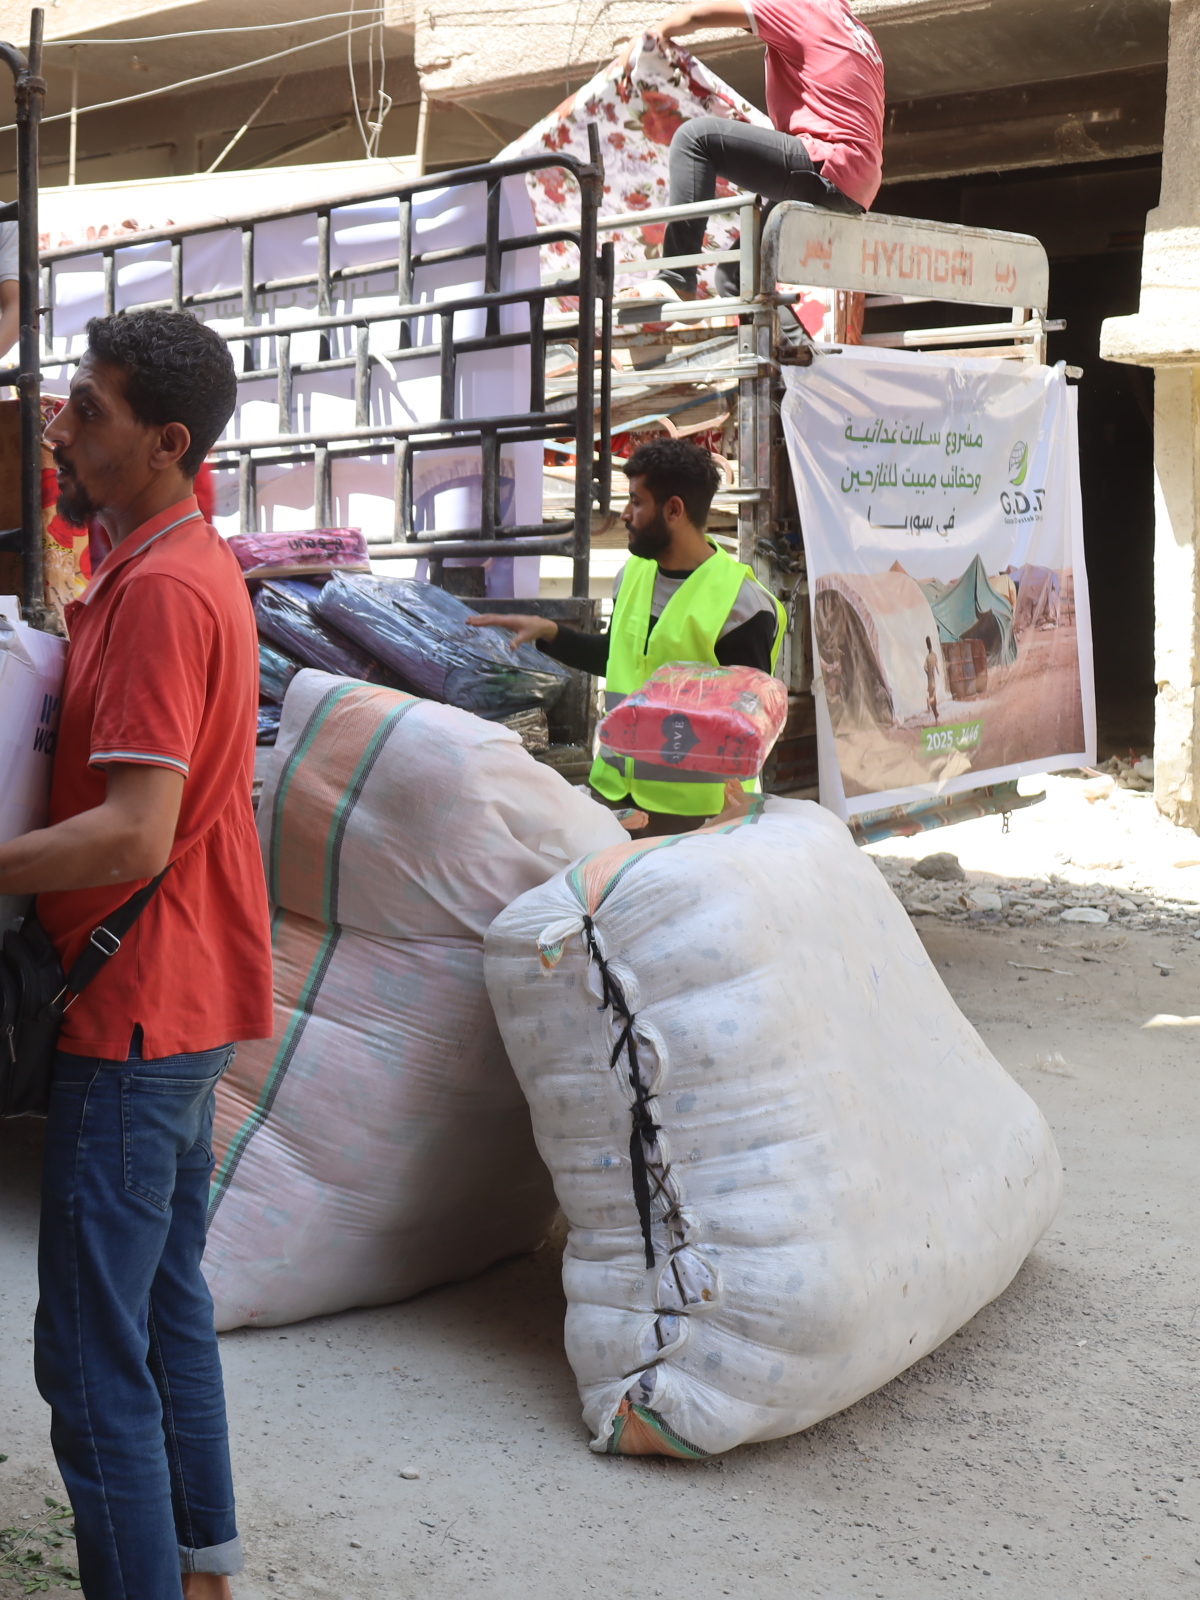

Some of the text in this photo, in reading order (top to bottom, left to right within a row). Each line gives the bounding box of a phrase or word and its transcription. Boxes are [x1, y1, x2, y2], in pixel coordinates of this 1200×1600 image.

[861, 239, 974, 286] HYUNDAI
[945, 424, 983, 456] مشروع
[840, 462, 982, 495] وحقائب مبيت للنازحين
[936, 507, 955, 543] في
[926, 730, 954, 751] 2025
